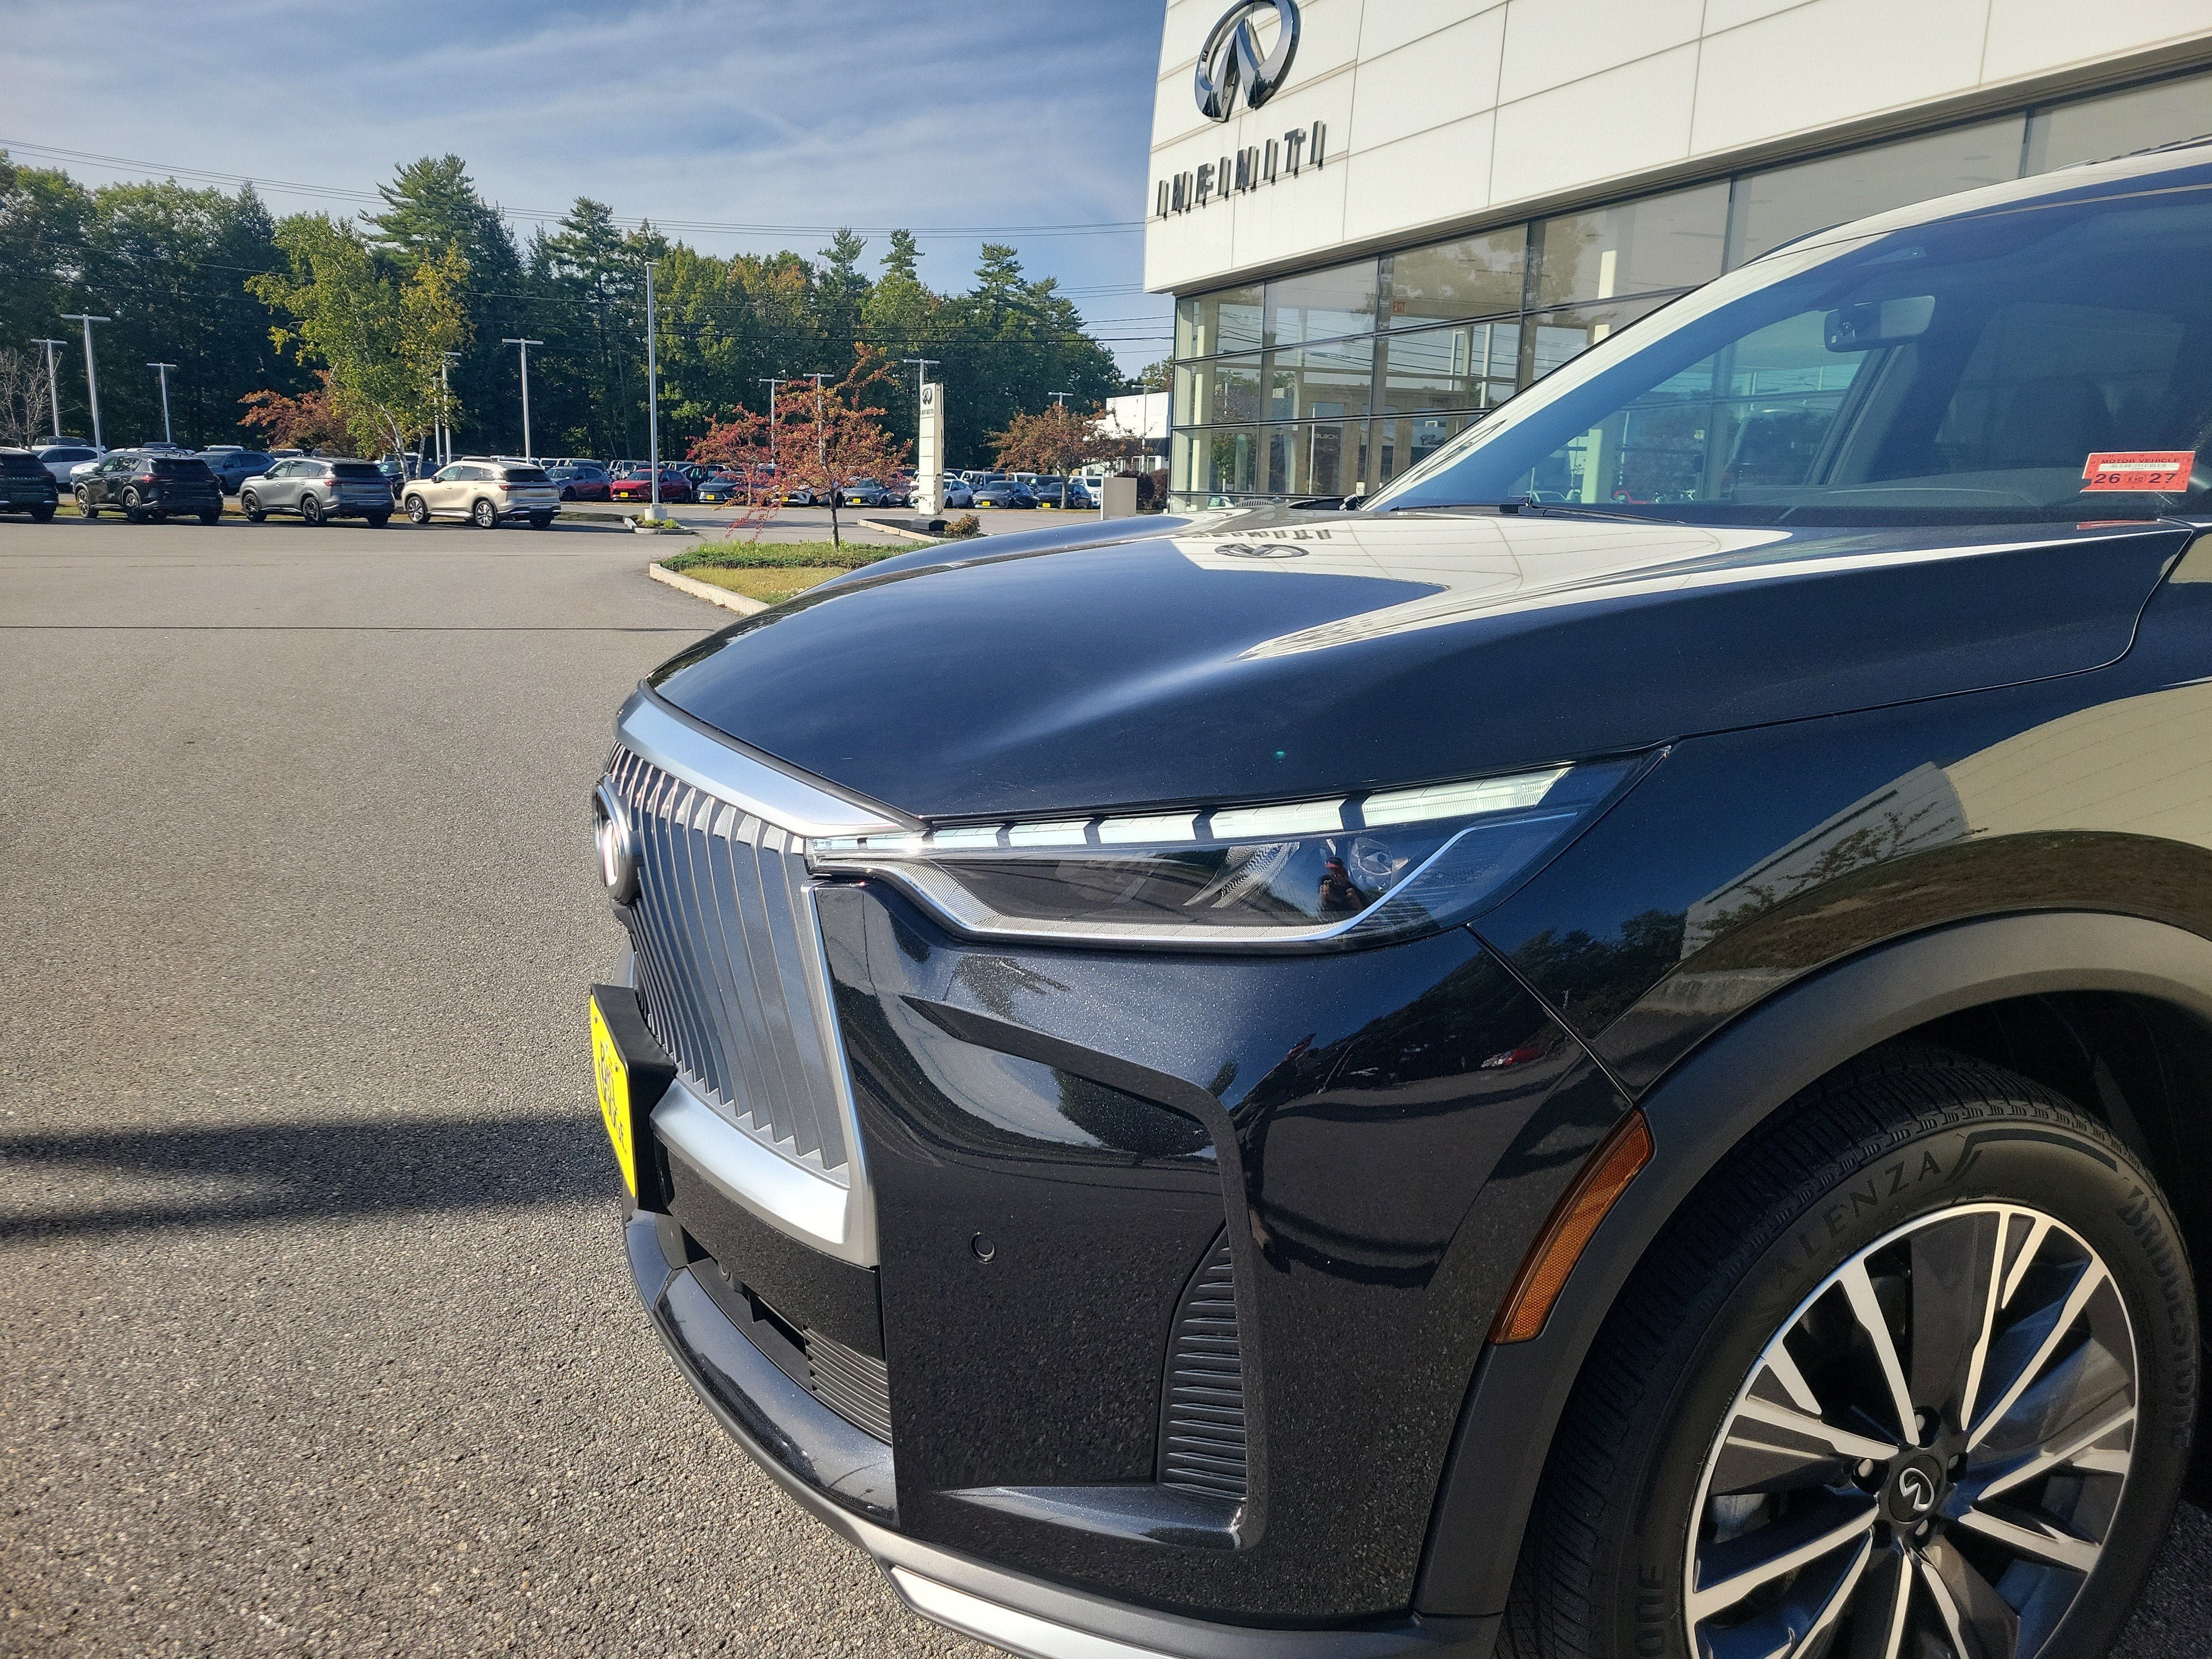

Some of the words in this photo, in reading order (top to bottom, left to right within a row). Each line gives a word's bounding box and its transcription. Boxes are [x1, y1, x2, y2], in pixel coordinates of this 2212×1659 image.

[1156, 120, 1324, 217] INFINITI
[1393, 301, 1406, 313] EXIT
[2094, 473, 2121, 484] 26
[2148, 472, 2177, 483] 27
[1773, 1150, 1942, 1290] ALENZA
